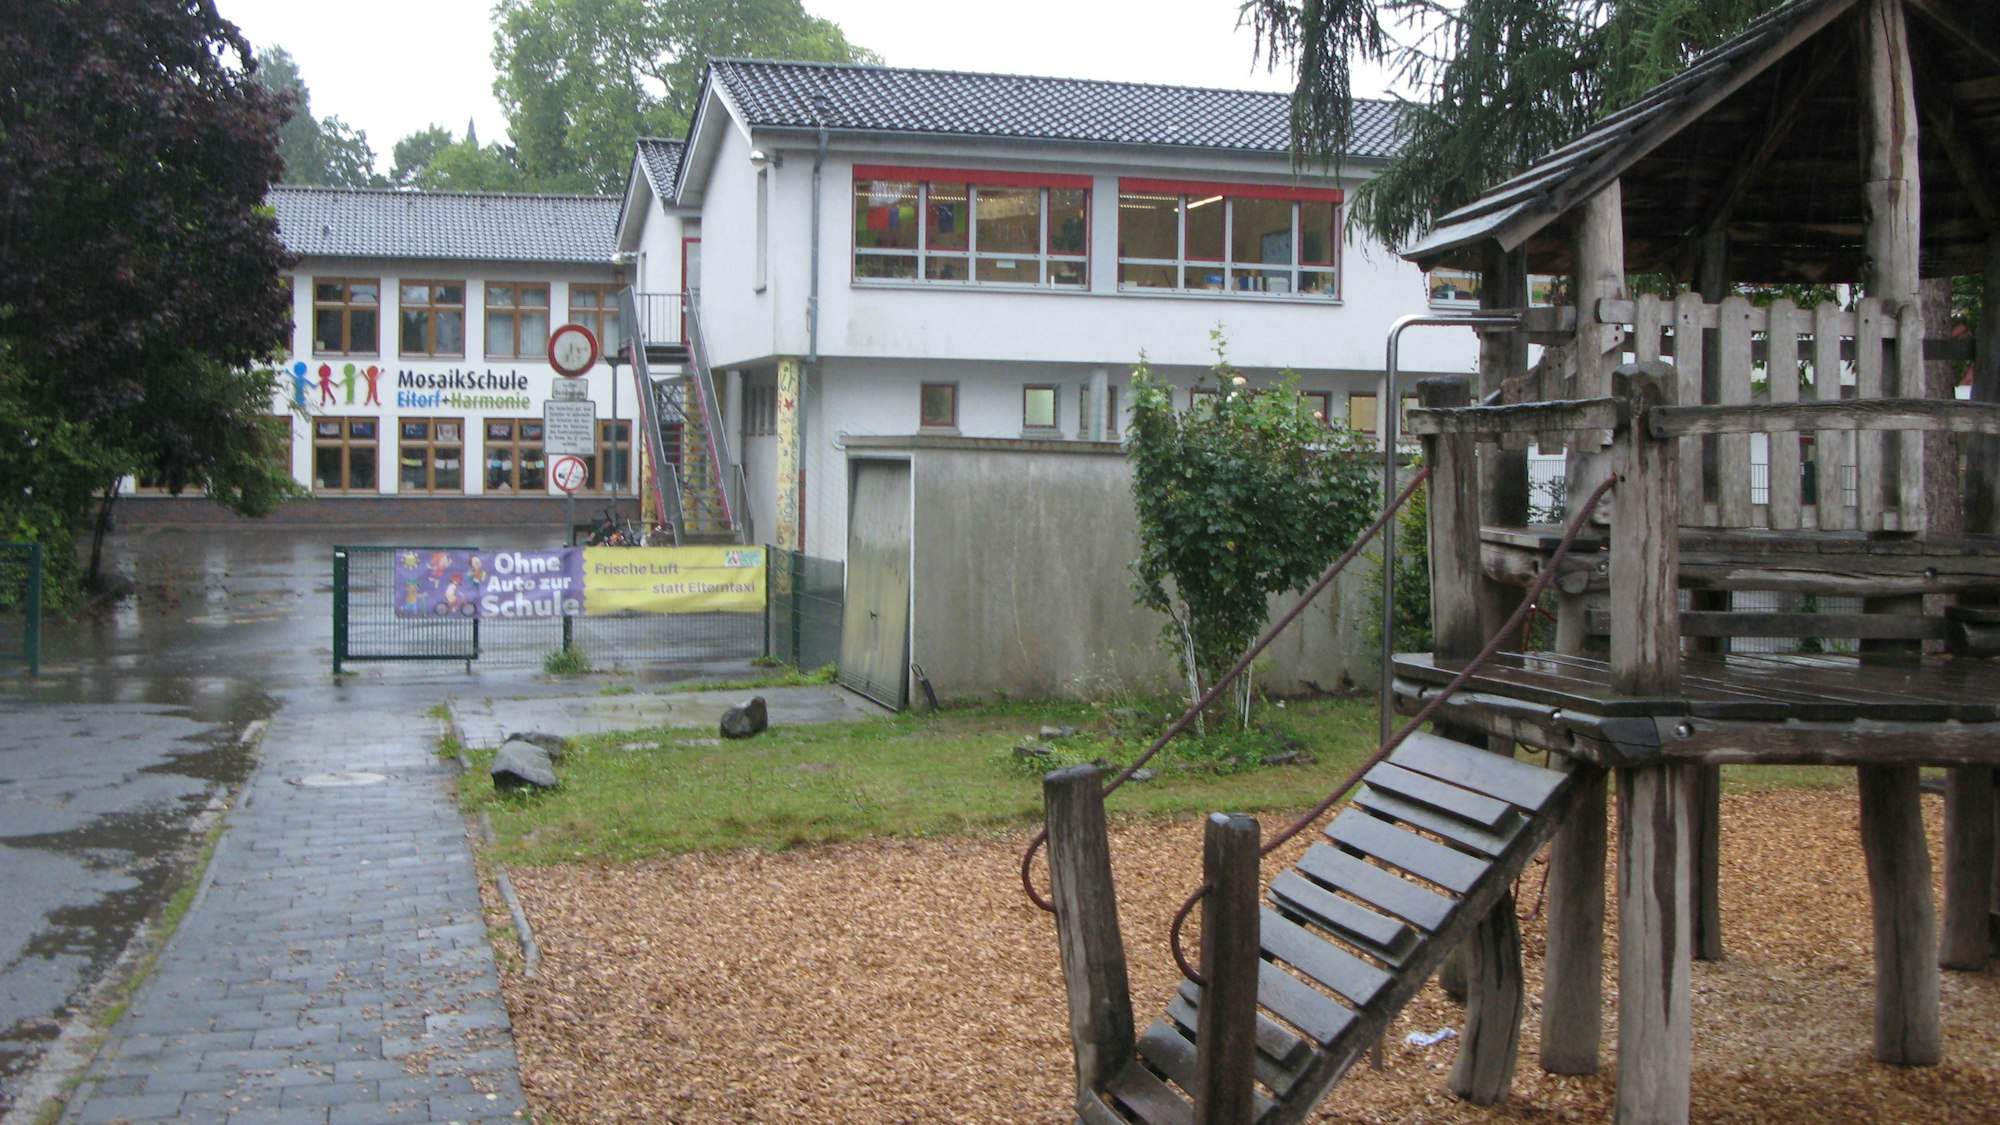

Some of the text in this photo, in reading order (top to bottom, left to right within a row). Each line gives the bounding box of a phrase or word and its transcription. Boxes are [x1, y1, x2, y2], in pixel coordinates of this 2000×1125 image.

[398, 369, 528, 389] MosaikSchule
[494, 552, 560, 574] Ohne
[595, 563, 679, 575] Frische Luft
[486, 576, 571, 592] Auto zur
[652, 581, 755, 594] statt Elterntaxi
[480, 590, 580, 617] Schule
